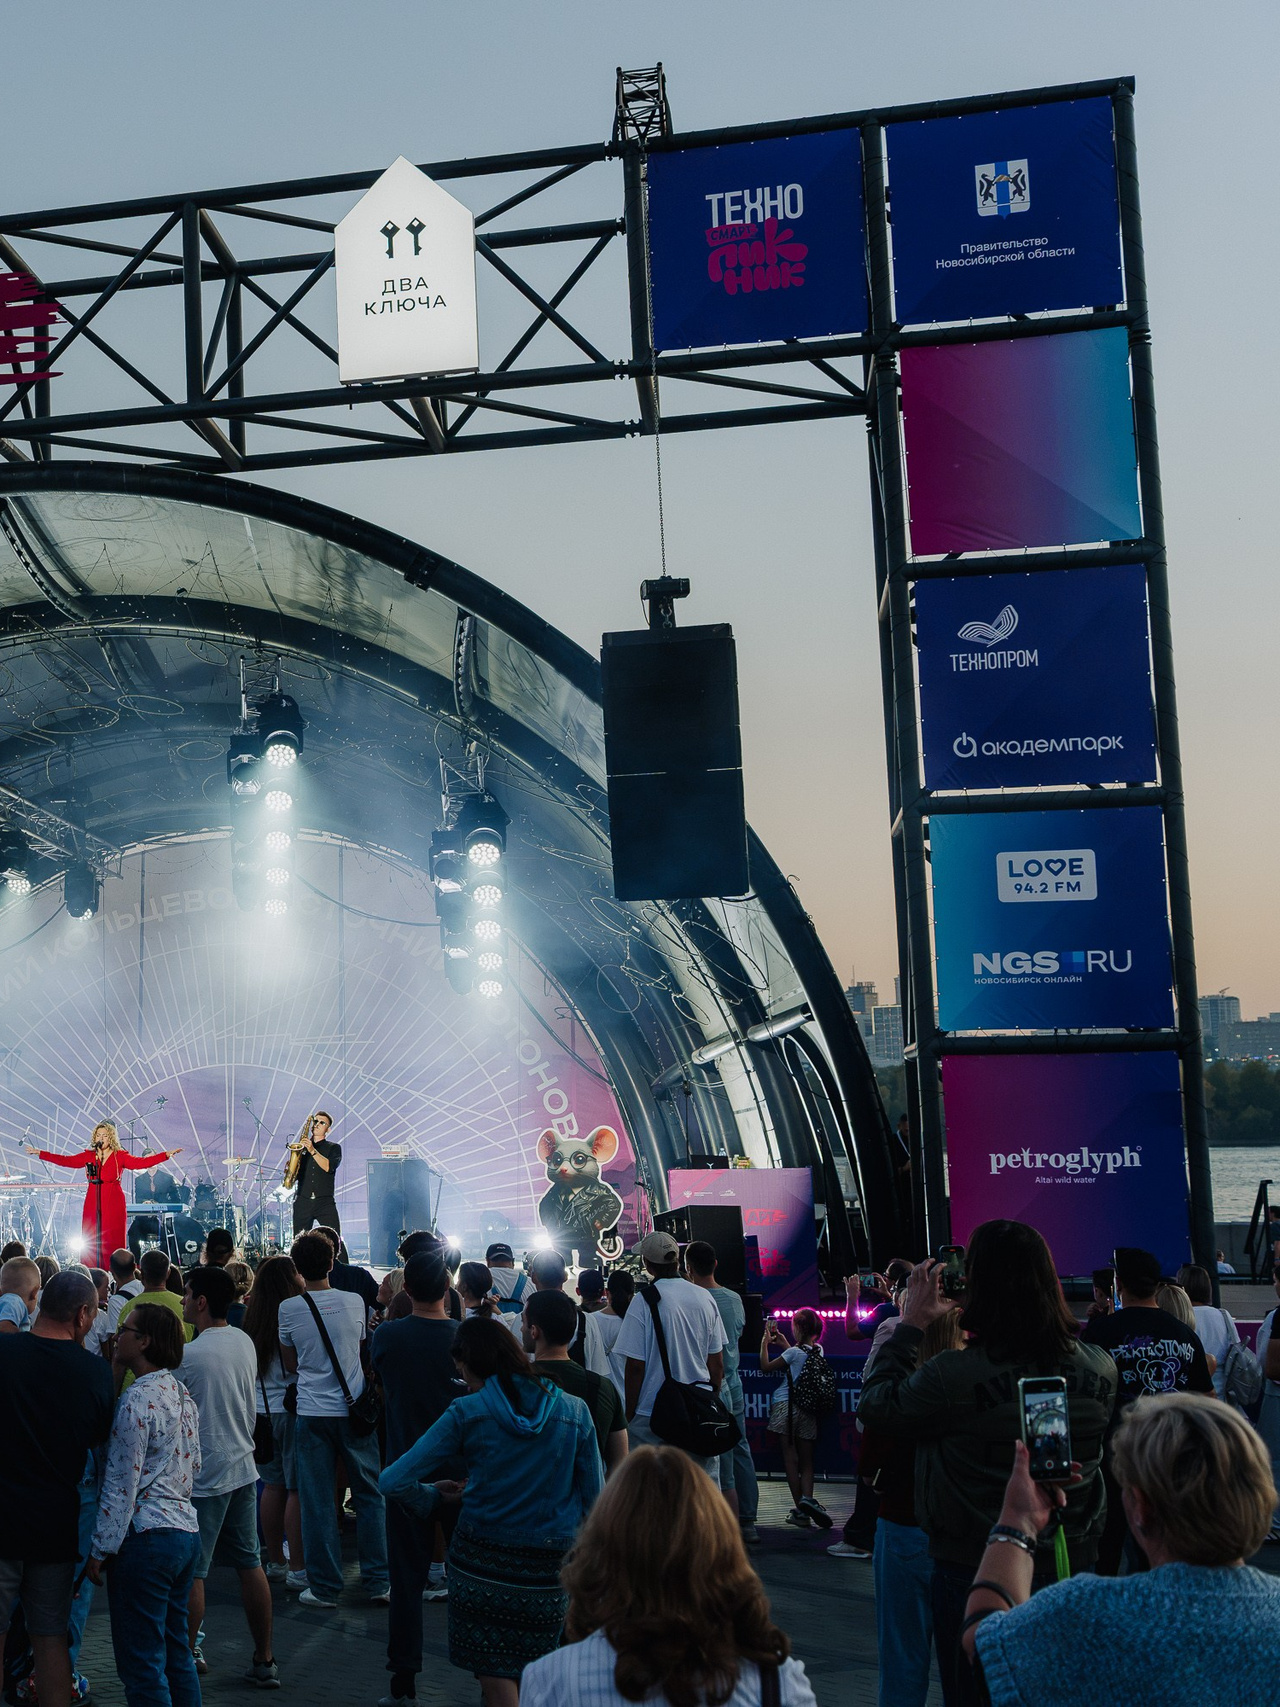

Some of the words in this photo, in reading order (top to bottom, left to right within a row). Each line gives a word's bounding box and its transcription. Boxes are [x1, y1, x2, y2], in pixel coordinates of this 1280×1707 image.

[705, 183, 804, 228] ТЕХНО
[960, 237, 1049, 254] Правительство
[935, 251, 1025, 269] Новосибирской
[1027, 247, 1076, 260] области
[381, 276, 429, 296] ДВА
[365, 294, 447, 316] КЛЮЧА
[949, 649, 1039, 672] ТЕХНОПРОМ
[1014, 882, 1049, 894] 94.2
[1055, 881, 1081, 893] FM
[42, 886, 239, 964] КОЛЬЦЕВО
[974, 976, 1042, 984] НОВОСИБИРСК
[1043, 975, 1083, 983] ОНЛАЙН
[1035, 1176, 1053, 1184] Altai
[1054, 1175, 1072, 1184] wild
[1073, 1176, 1096, 1184] water
